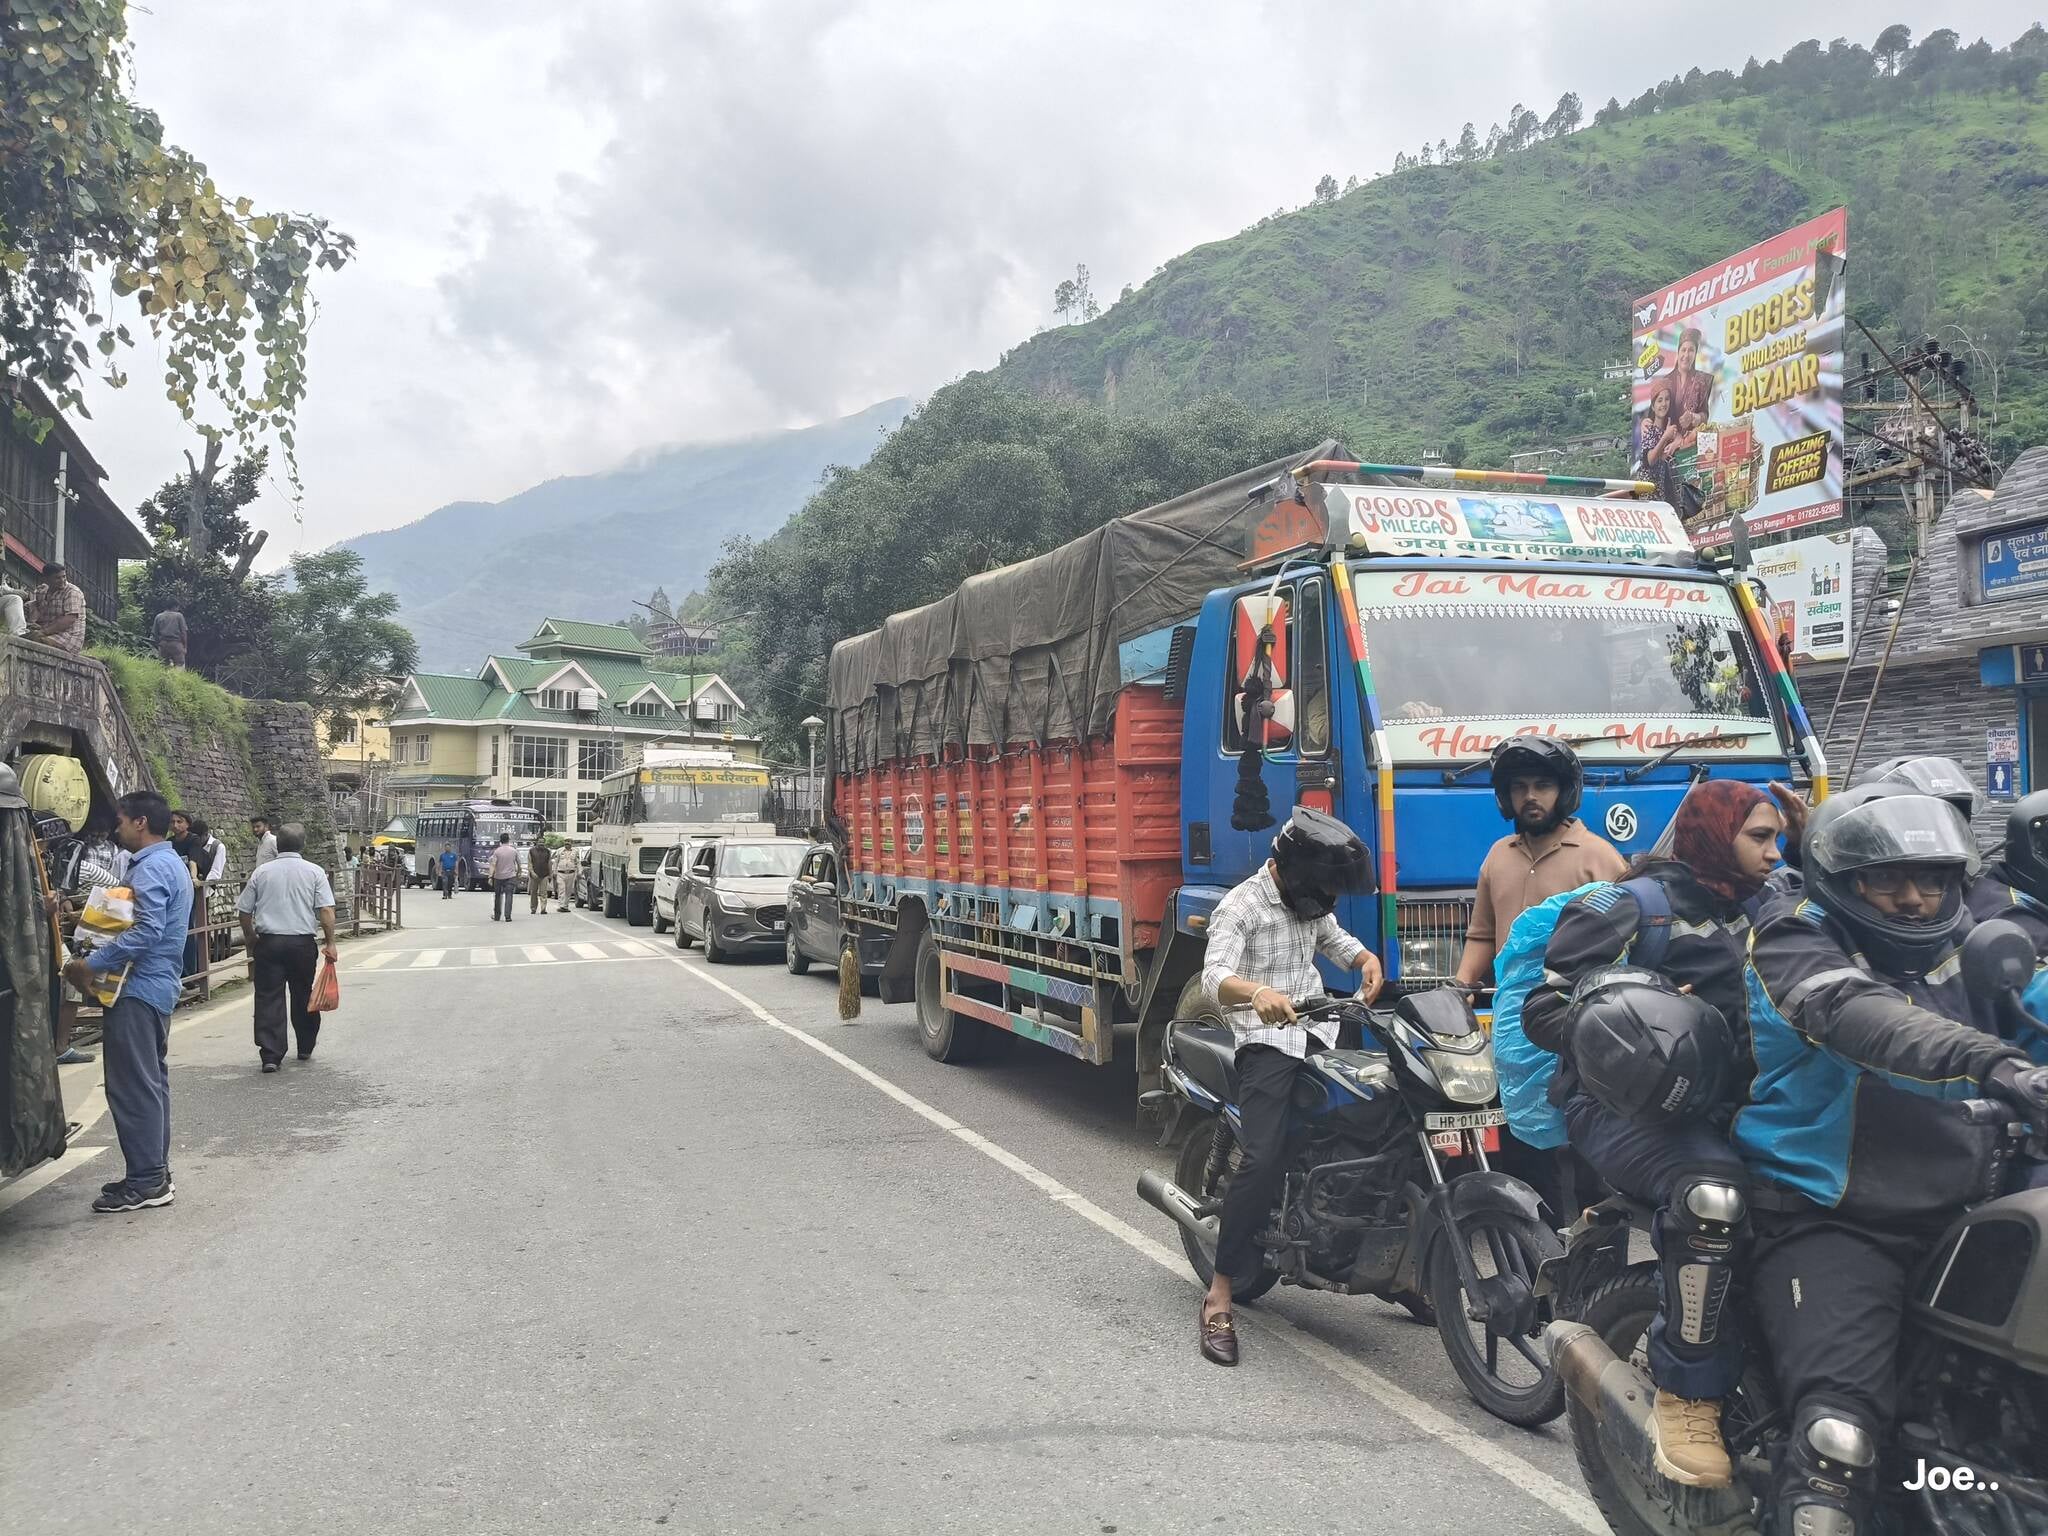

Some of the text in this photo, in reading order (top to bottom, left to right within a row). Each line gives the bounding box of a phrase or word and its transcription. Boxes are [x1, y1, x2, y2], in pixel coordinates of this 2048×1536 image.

[1658, 258, 1760, 321] Amartex
[1762, 246, 1805, 272] Family
[1741, 330, 1807, 374] WHOLESALE
[1731, 353, 1820, 417] BAZAAR
[1776, 435, 1825, 462] AMAZING
[1772, 466, 1820, 490] EVERYDAY
[1776, 451, 1821, 478] OFFERS
[1355, 496, 1458, 535] GOODS
[1381, 518, 1443, 534] MILEGA
[1577, 506, 1672, 544] CARRIER
[1393, 537, 1448, 550] जय
[1594, 526, 1660, 545] MUQADAR
[1757, 560, 1798, 578] हिमाचल
[1392, 571, 1711, 608] Jai Maa Jalpa
[1418, 725, 1504, 758] Har
[1440, 1116, 1455, 1129] HR
[1460, 1113, 1487, 1127] 01AU
